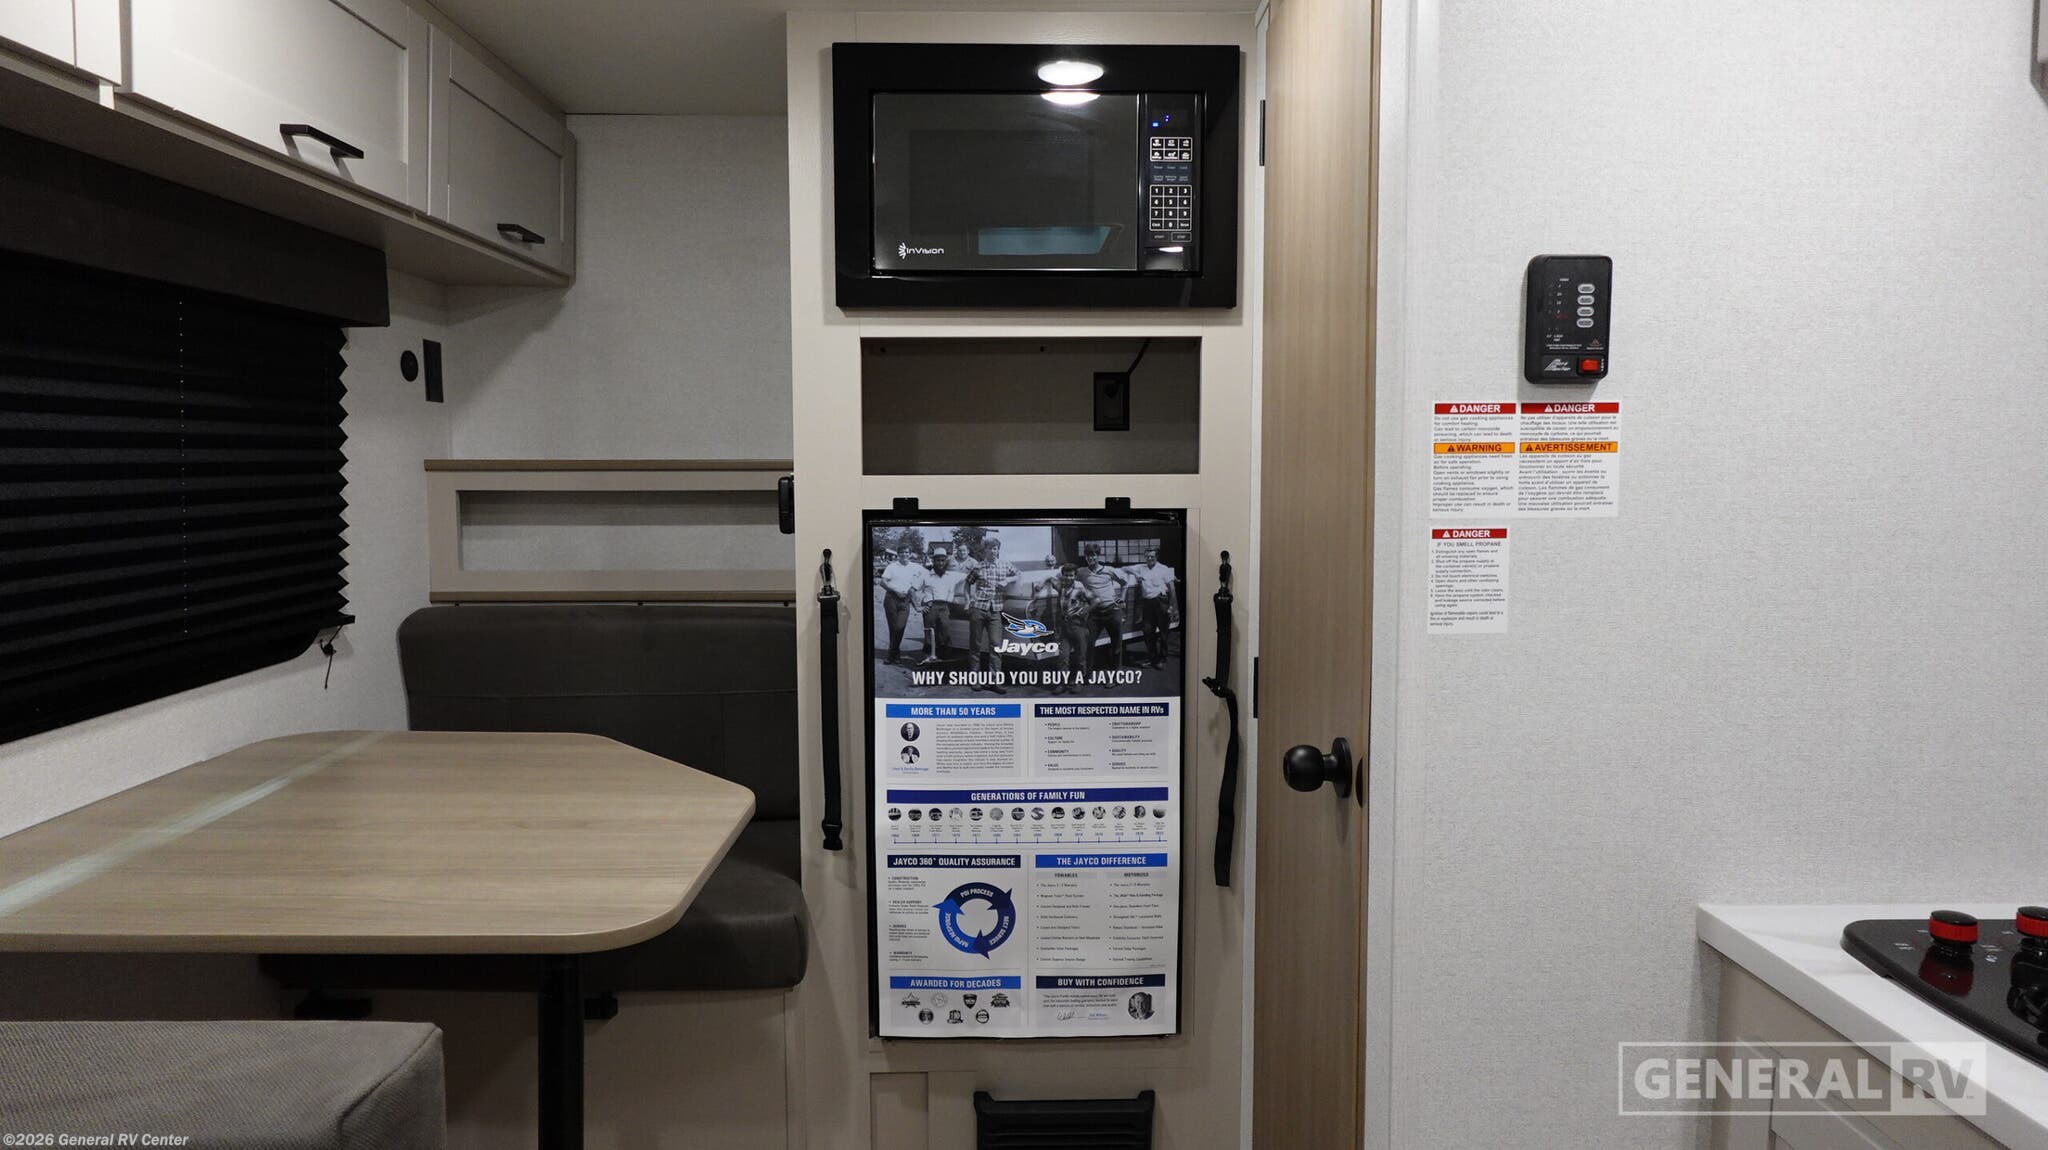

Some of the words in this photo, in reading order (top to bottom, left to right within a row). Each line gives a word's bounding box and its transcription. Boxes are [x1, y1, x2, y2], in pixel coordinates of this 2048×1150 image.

[1460, 404, 1500, 413] DANGER
[1554, 404, 1595, 412] DANGER
[994, 639, 1059, 656] Jayco
[912, 671, 944, 685] WHY
[949, 671, 1005, 685] SHOULD
[1010, 671, 1037, 685] YOU
[1043, 670, 1071, 684] BUY
[1075, 670, 1084, 684] A
[1089, 670, 1142, 684] JAYCO?
[971, 792, 1025, 801] GENERATIONS
[1027, 792, 1037, 801] OF
[1039, 792, 1068, 800] FAMILY
[1069, 791, 1085, 800] FUN
[939, 858, 970, 866] QUALITY
[970, 889, 994, 897] PROCESS
[967, 980, 1001, 988] DECADES
[1058, 978, 1074, 986] BUY
[1076, 978, 1095, 986] WITH
[1097, 977, 1144, 985] CONFIDENCE
